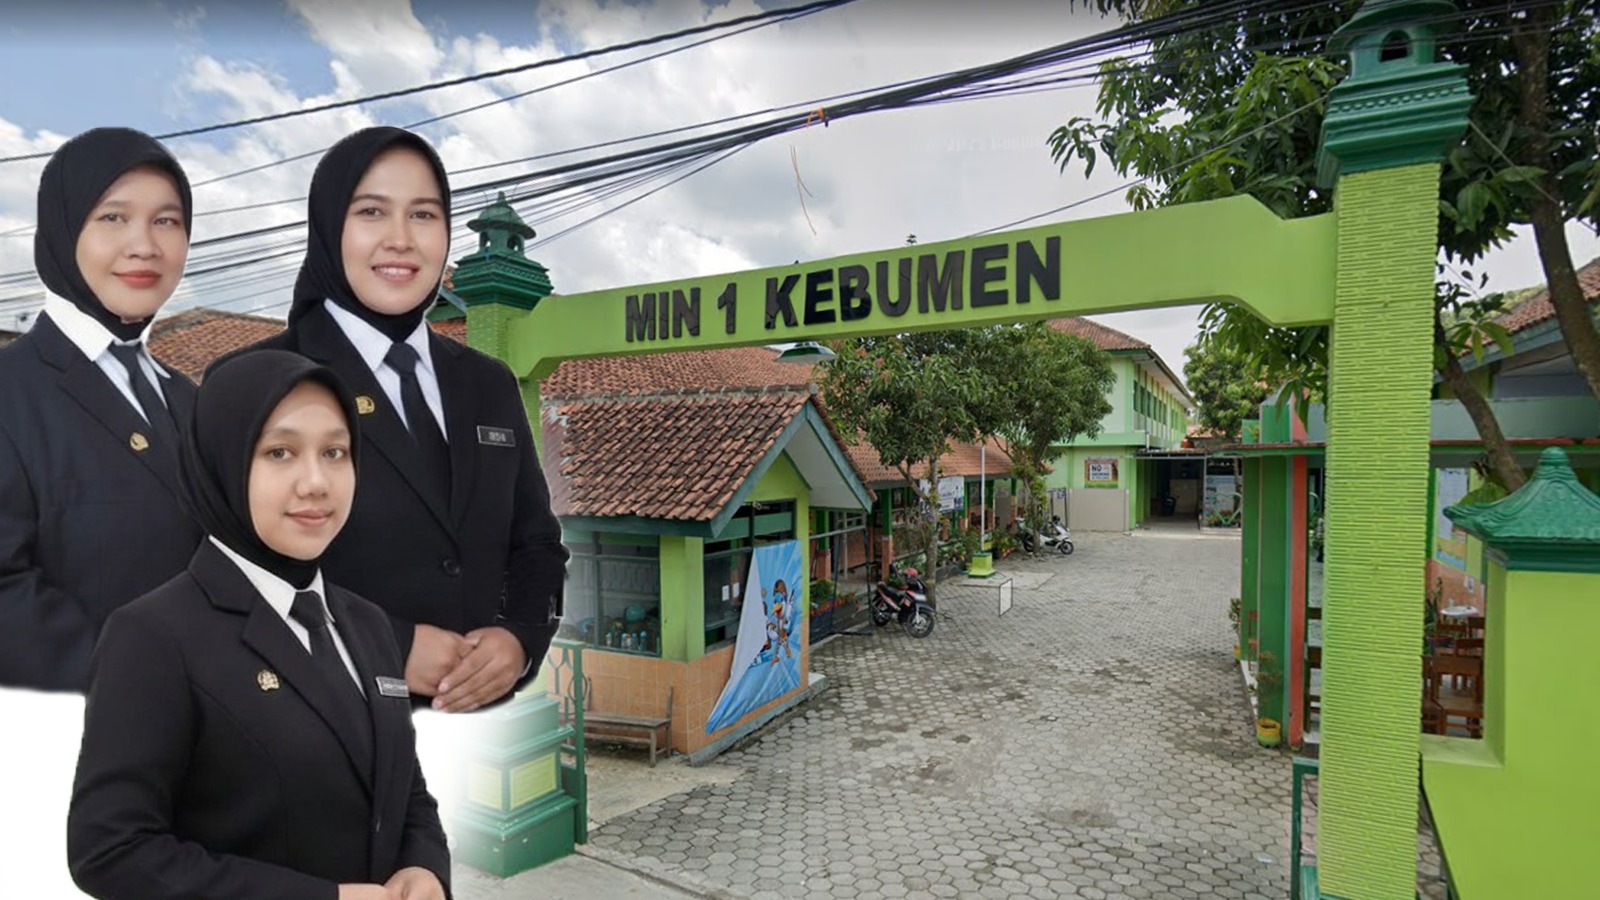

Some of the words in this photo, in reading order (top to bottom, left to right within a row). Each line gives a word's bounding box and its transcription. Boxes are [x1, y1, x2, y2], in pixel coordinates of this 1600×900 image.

[625, 286, 701, 343] MIN
[717, 282, 737, 335] 1
[765, 236, 1061, 330] KEBUMEN
[1091, 464, 1102, 472] NO
